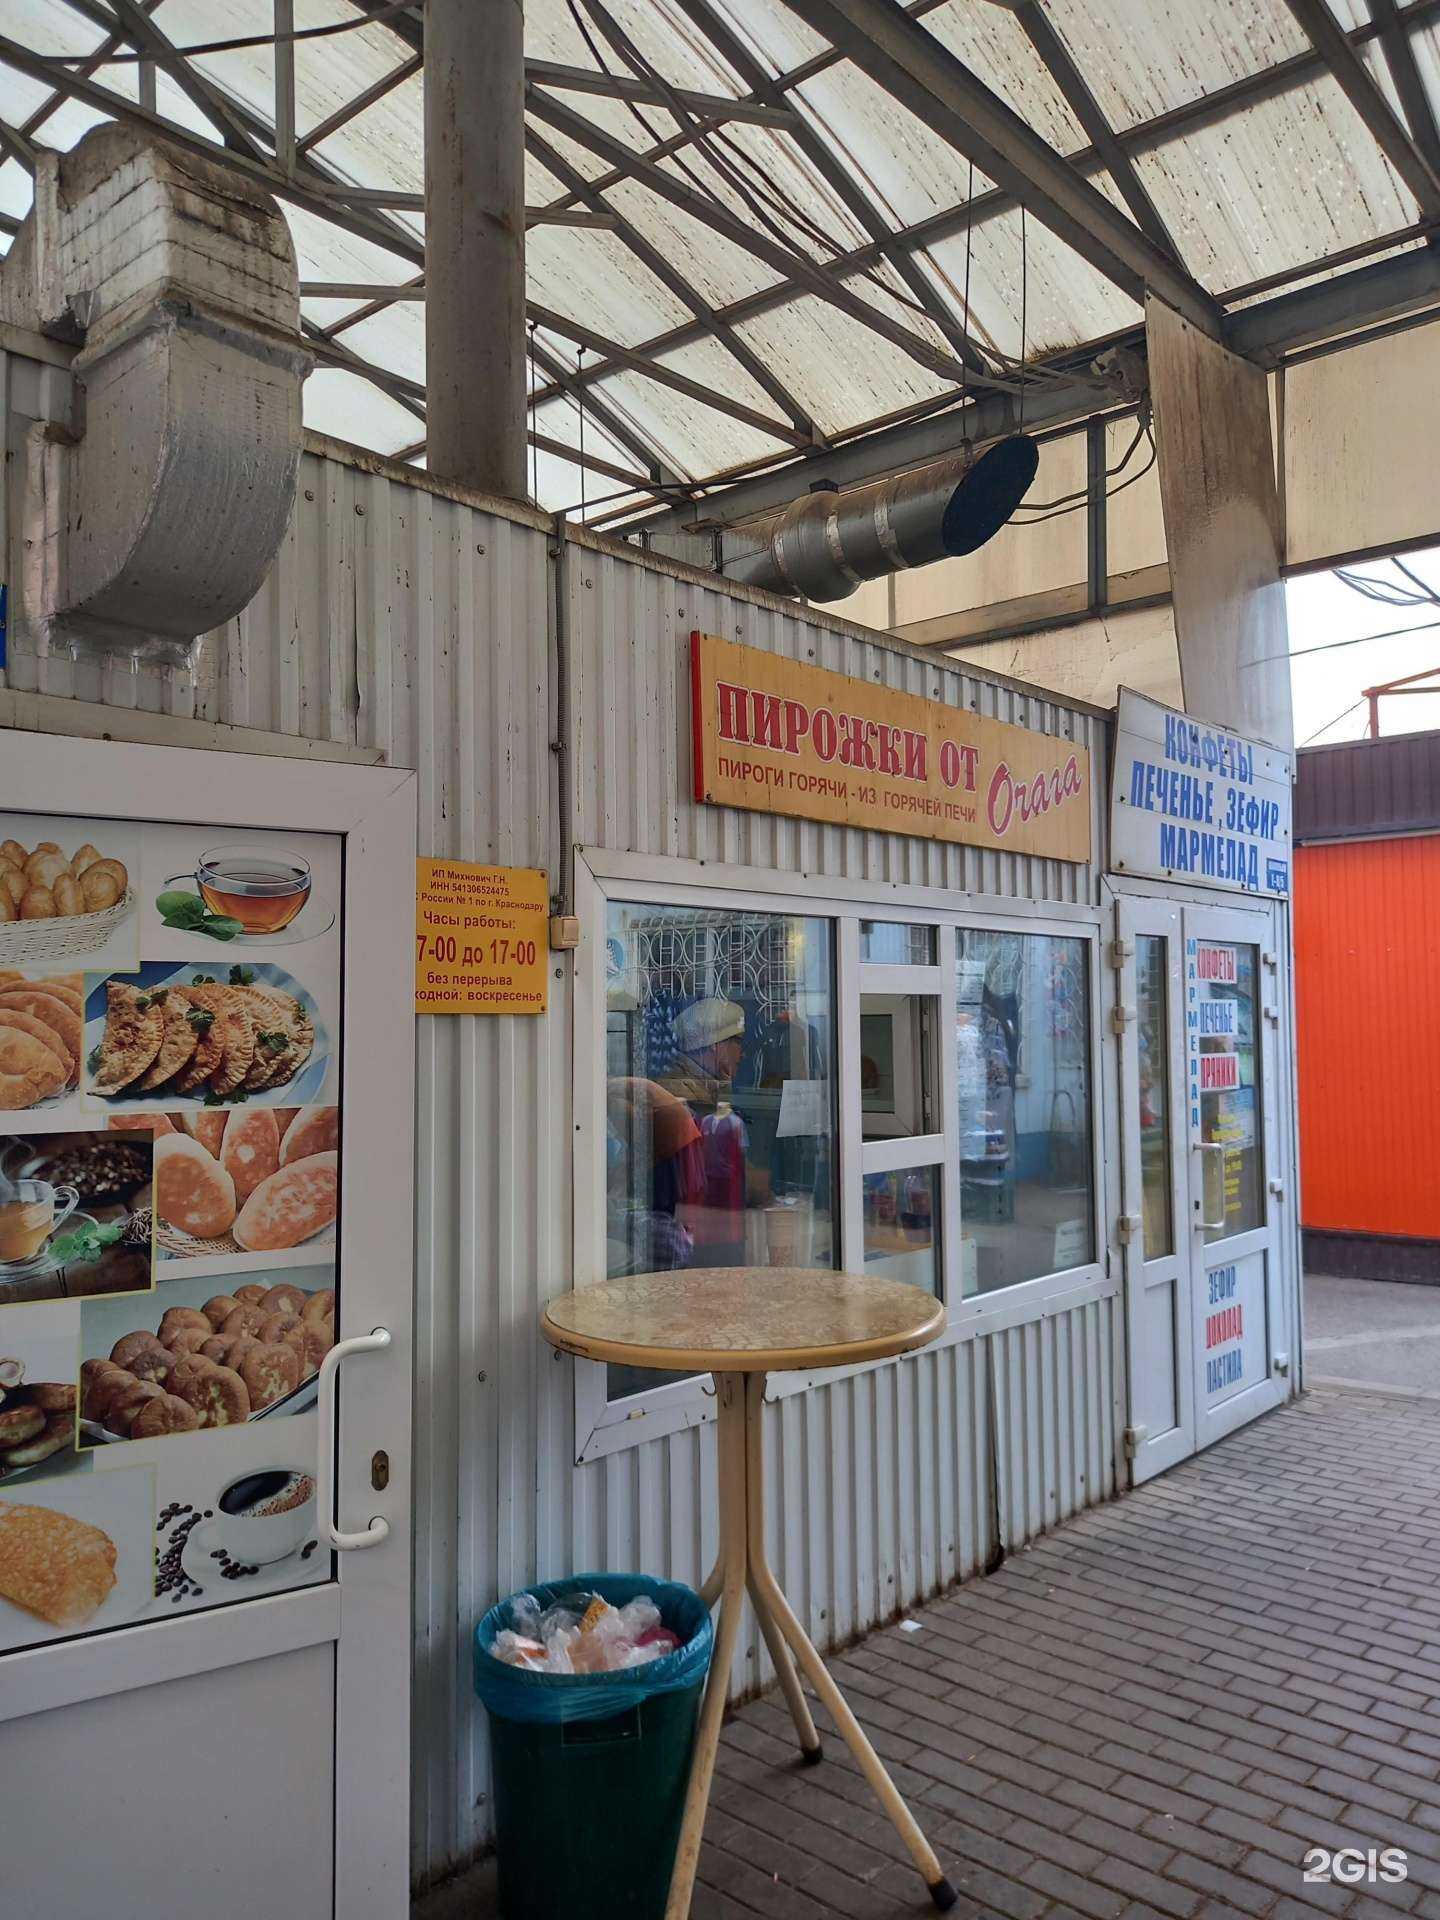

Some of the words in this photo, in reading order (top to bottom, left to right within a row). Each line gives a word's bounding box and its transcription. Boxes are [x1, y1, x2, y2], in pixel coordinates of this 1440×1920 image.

[714, 680, 929, 783] ПИРОЖКИ
[939, 739, 979, 792] ОТ
[987, 753, 1082, 838] Очага
[1164, 714, 1253, 785] КОНФЕТЫ
[718, 757, 784, 788] ПИРОГИ
[789, 772, 848, 799] ГОРЯЧИ
[859, 787, 876, 805] ИЗ
[884, 791, 942, 818] ГОРЯЧЕЙ
[944, 802, 976, 824] ПЕЧИ
[1226, 787, 1279, 840] ЗЕФИР
[1160, 823, 1259, 892] МАРМЕЛАД
[430, 881, 450, 892] ИНН
[432, 868, 445, 878] ИП
[447, 870, 491, 883] Михнович
[421, 892, 455, 904] России
[468, 896, 473, 905] 1
[475, 898, 486, 906] по
[495, 900, 544, 913] Краснодару
[423, 911, 460, 926] Часы
[464, 914, 516, 929] работы:
[461, 945, 483, 967] до
[490, 938, 536, 966] 17-00
[1197, 947, 1235, 982] КОНФЕТЫ
[427, 971, 448, 985] без
[452, 975, 513, 988] перерыва
[467, 991, 542, 1003] воскресенье
[1186, 938, 1200, 1128] МАРМЕЛАД
[1200, 1002, 1233, 1035] ПЕЧЕНЬЕ
[1200, 1056, 1236, 1089] ПРЯНИКИ
[1208, 1264, 1236, 1305] ЗЕФИР
[1206, 1348, 1243, 1394] ПАСТИЛА
